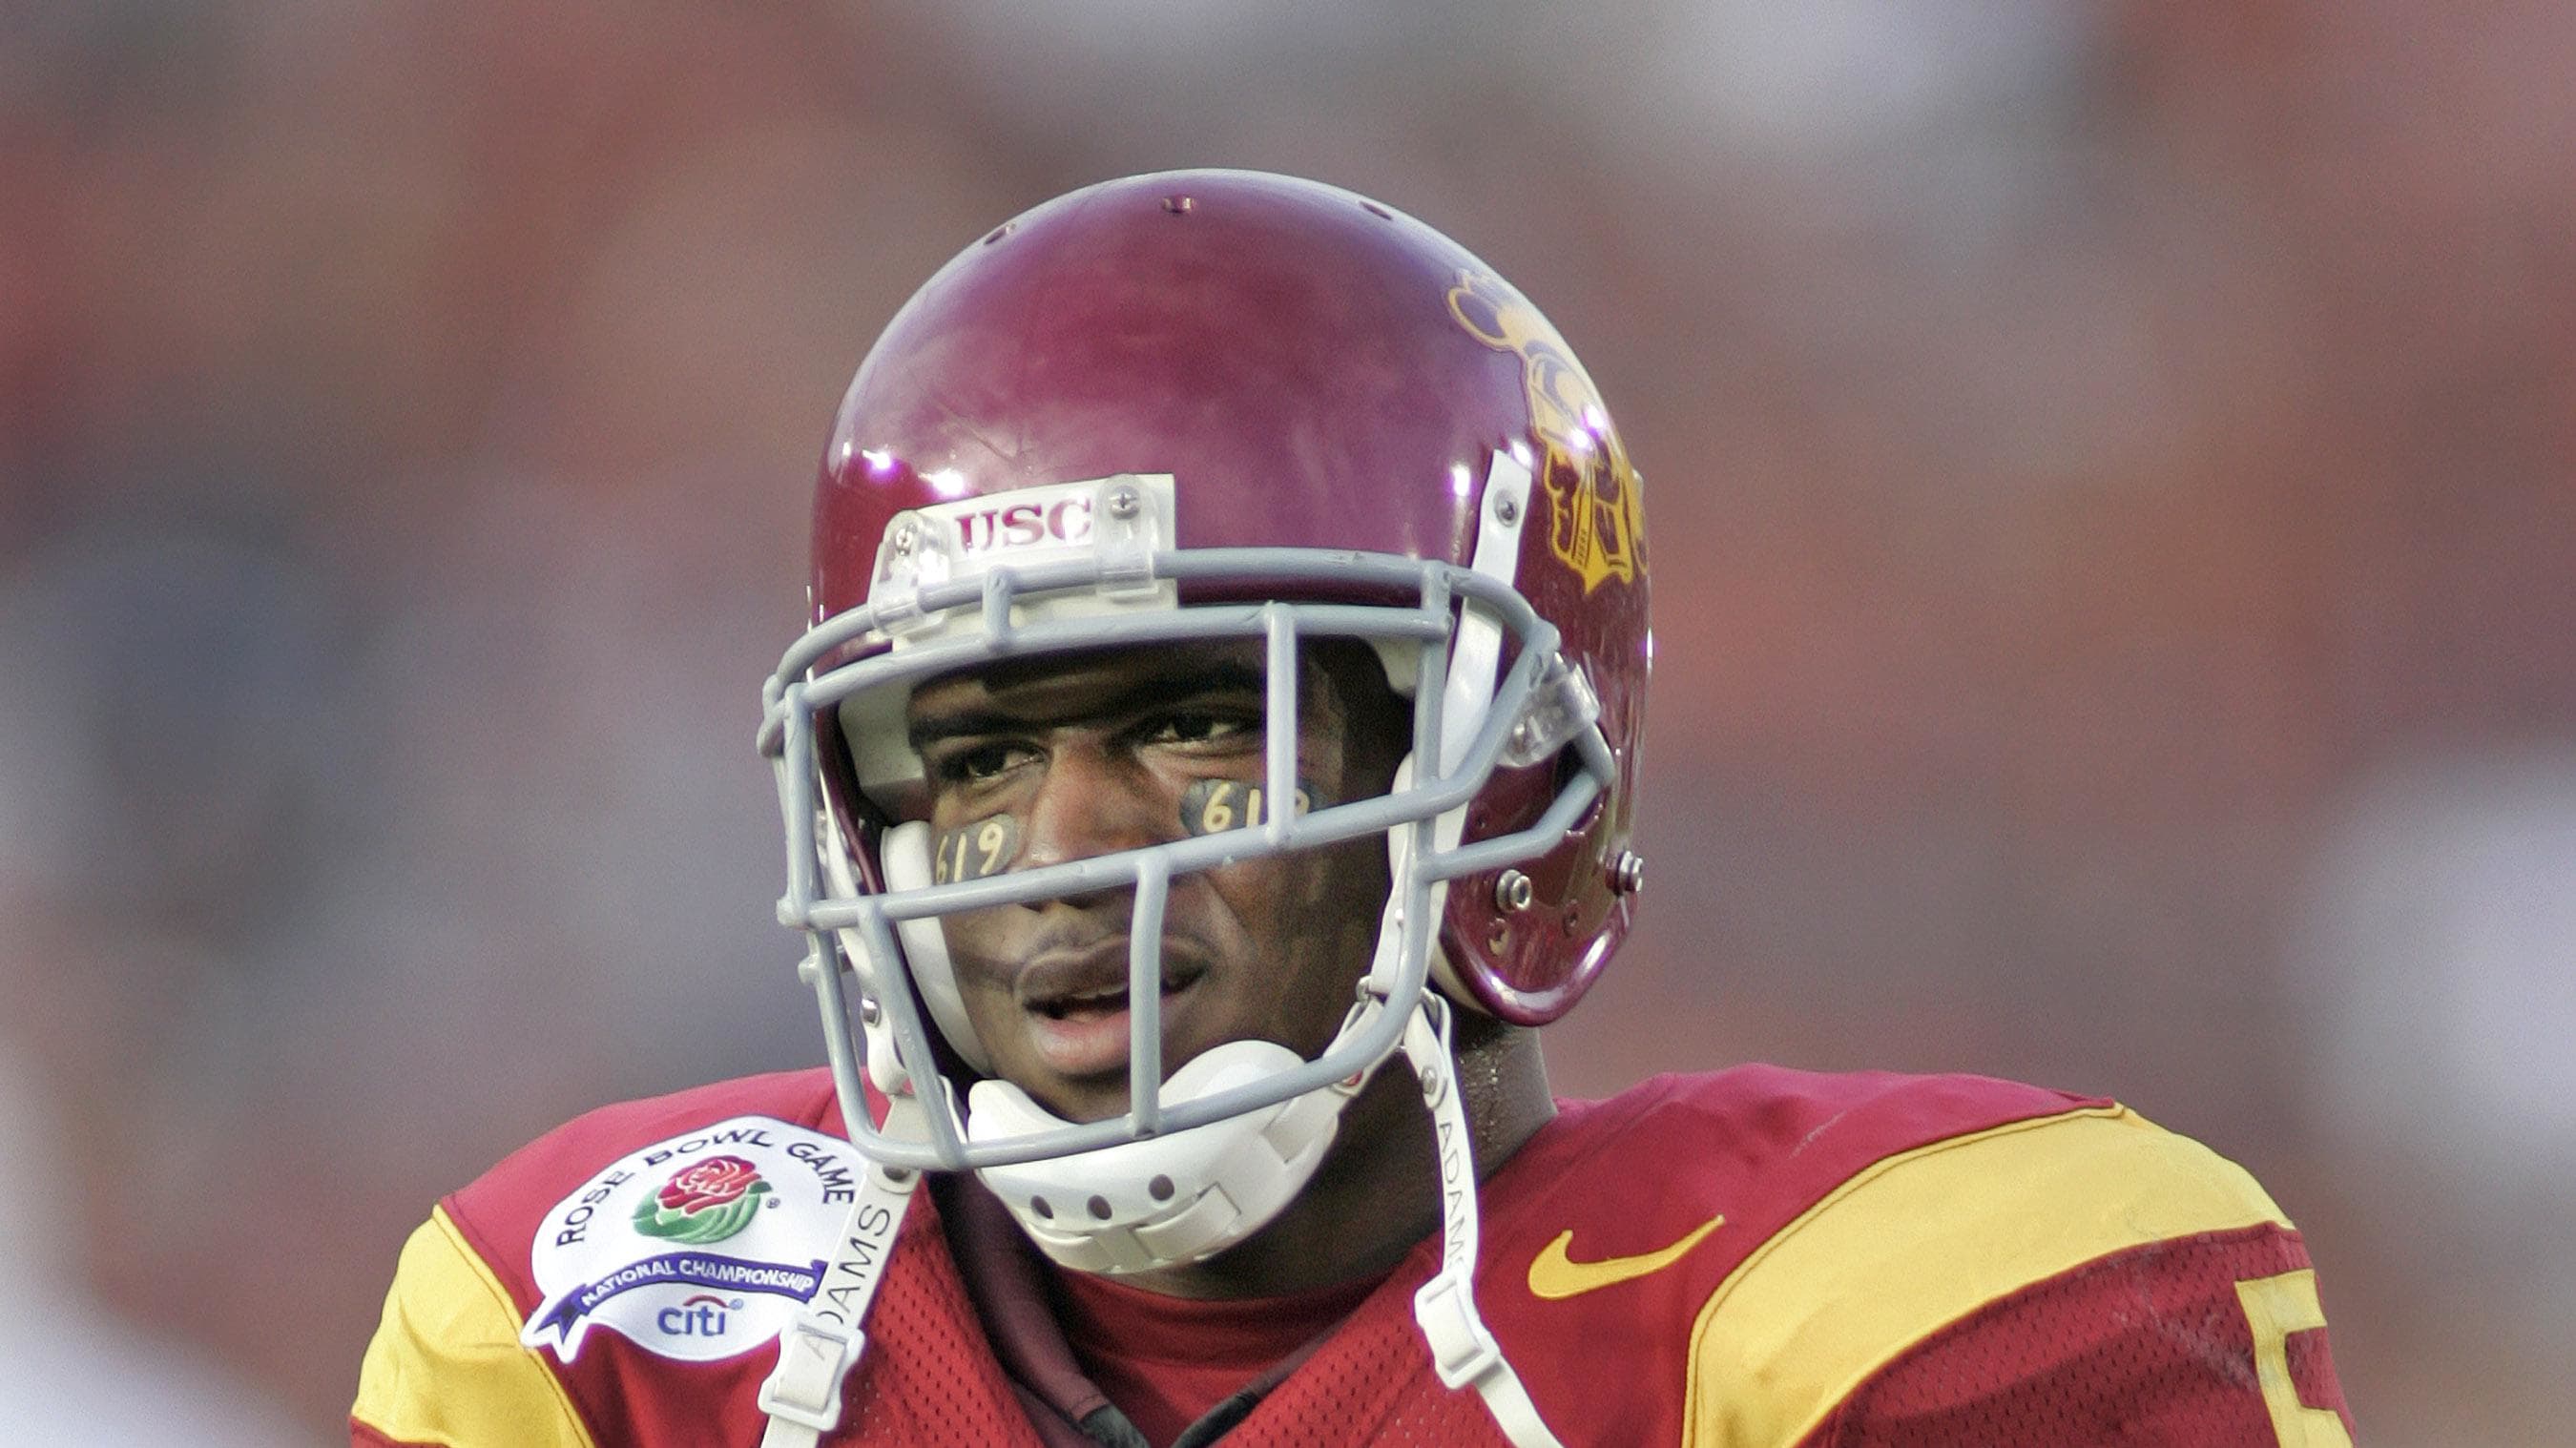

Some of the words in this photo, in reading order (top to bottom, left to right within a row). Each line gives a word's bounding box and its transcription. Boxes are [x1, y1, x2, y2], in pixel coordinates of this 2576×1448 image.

[955, 497, 1091, 552] USC
[936, 822, 1004, 886] 619
[556, 1169, 634, 1247] ROSE
[642, 1129, 775, 1166] BOWL
[786, 1143, 854, 1205] GAME
[1439, 1123, 1466, 1269] ADAM
[581, 1260, 676, 1307] NATIONAL
[679, 1259, 816, 1293] CHAMPIONSHIP
[657, 1305, 726, 1336] citi
